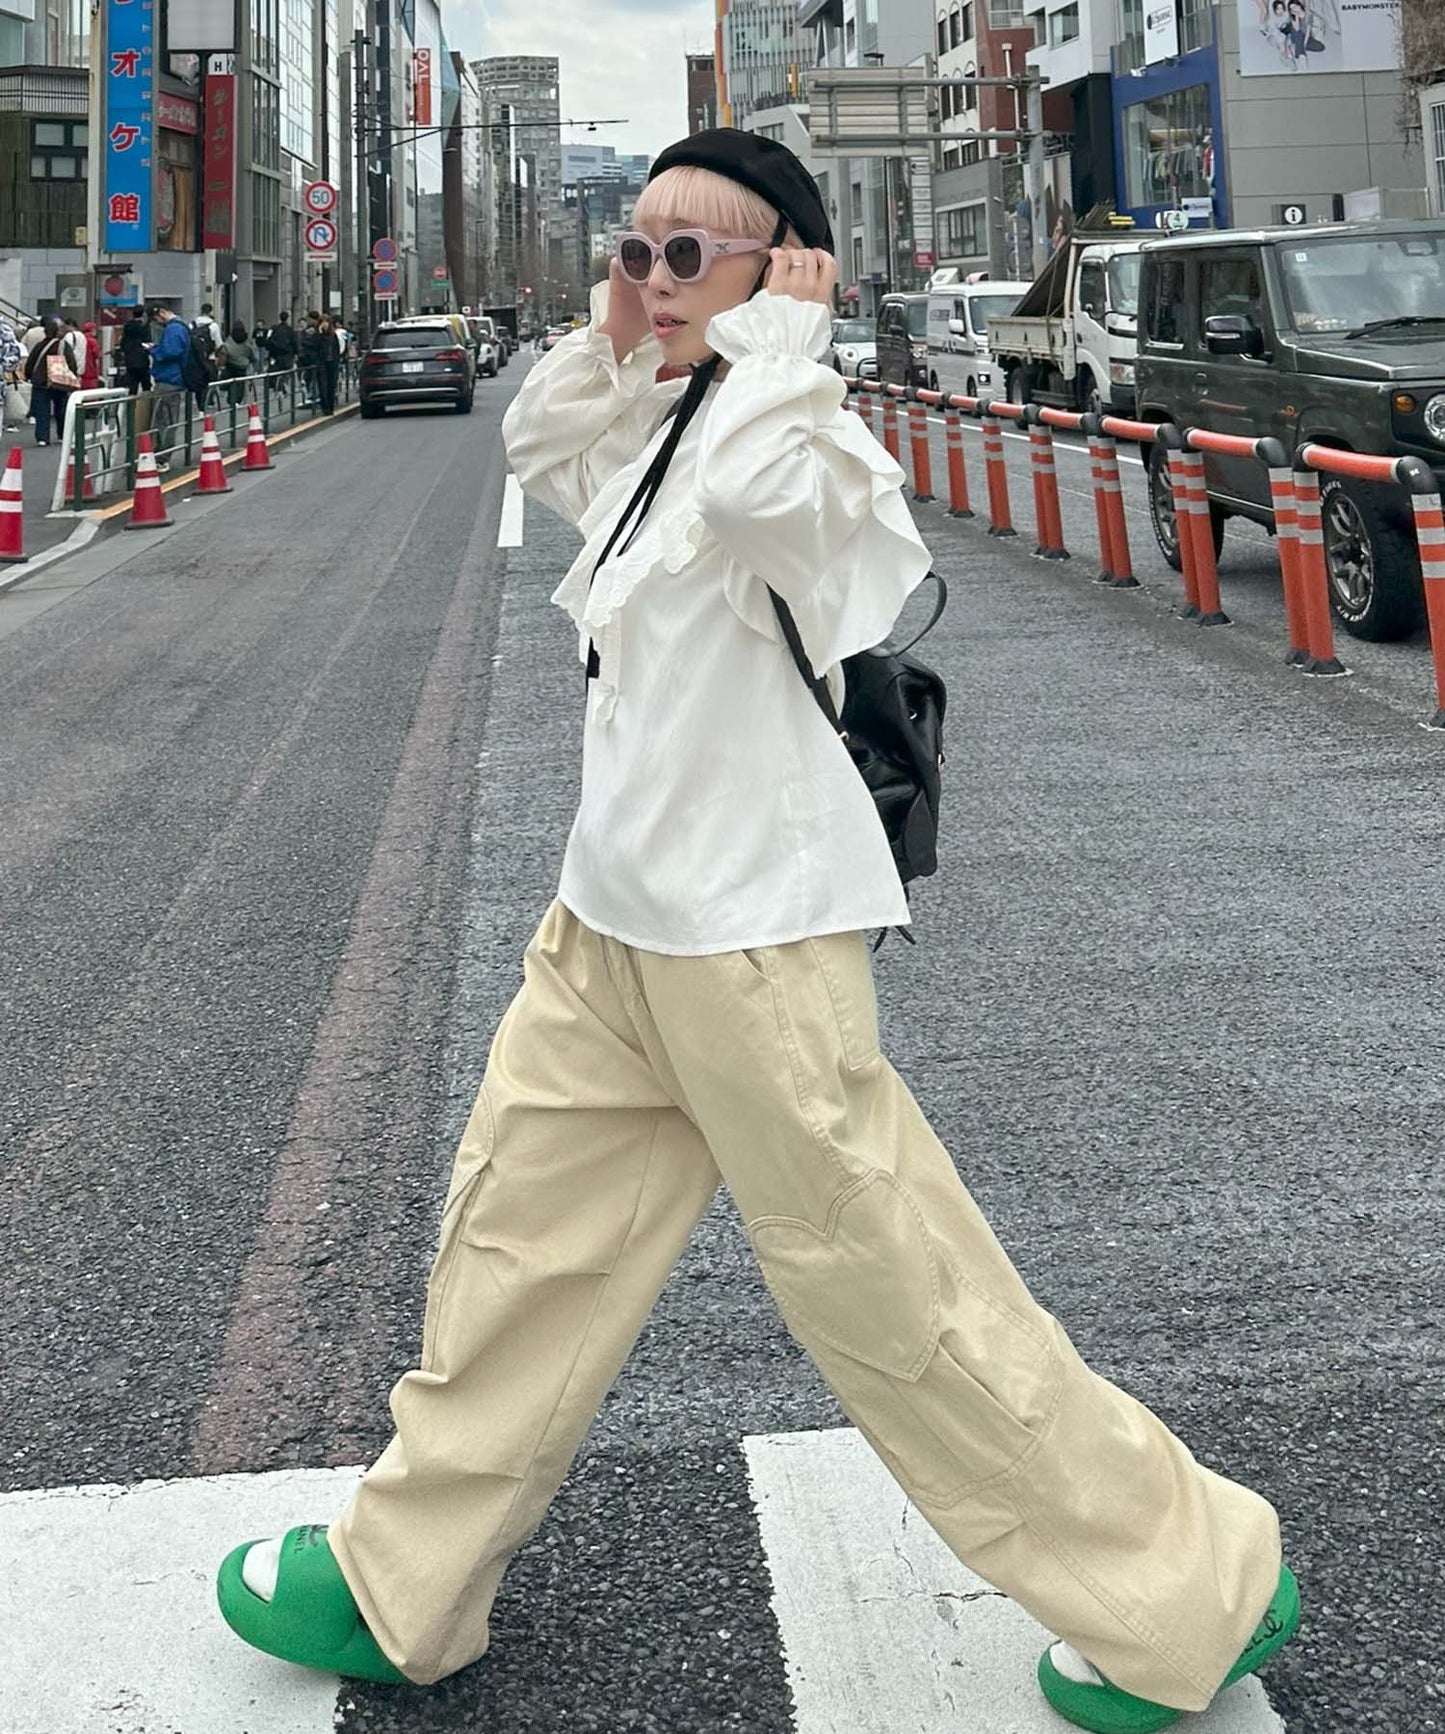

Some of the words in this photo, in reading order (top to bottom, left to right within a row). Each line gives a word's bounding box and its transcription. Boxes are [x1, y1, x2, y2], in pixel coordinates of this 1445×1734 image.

[108, 0, 141, 223] オケ館
[312, 190, 330, 205] 50
